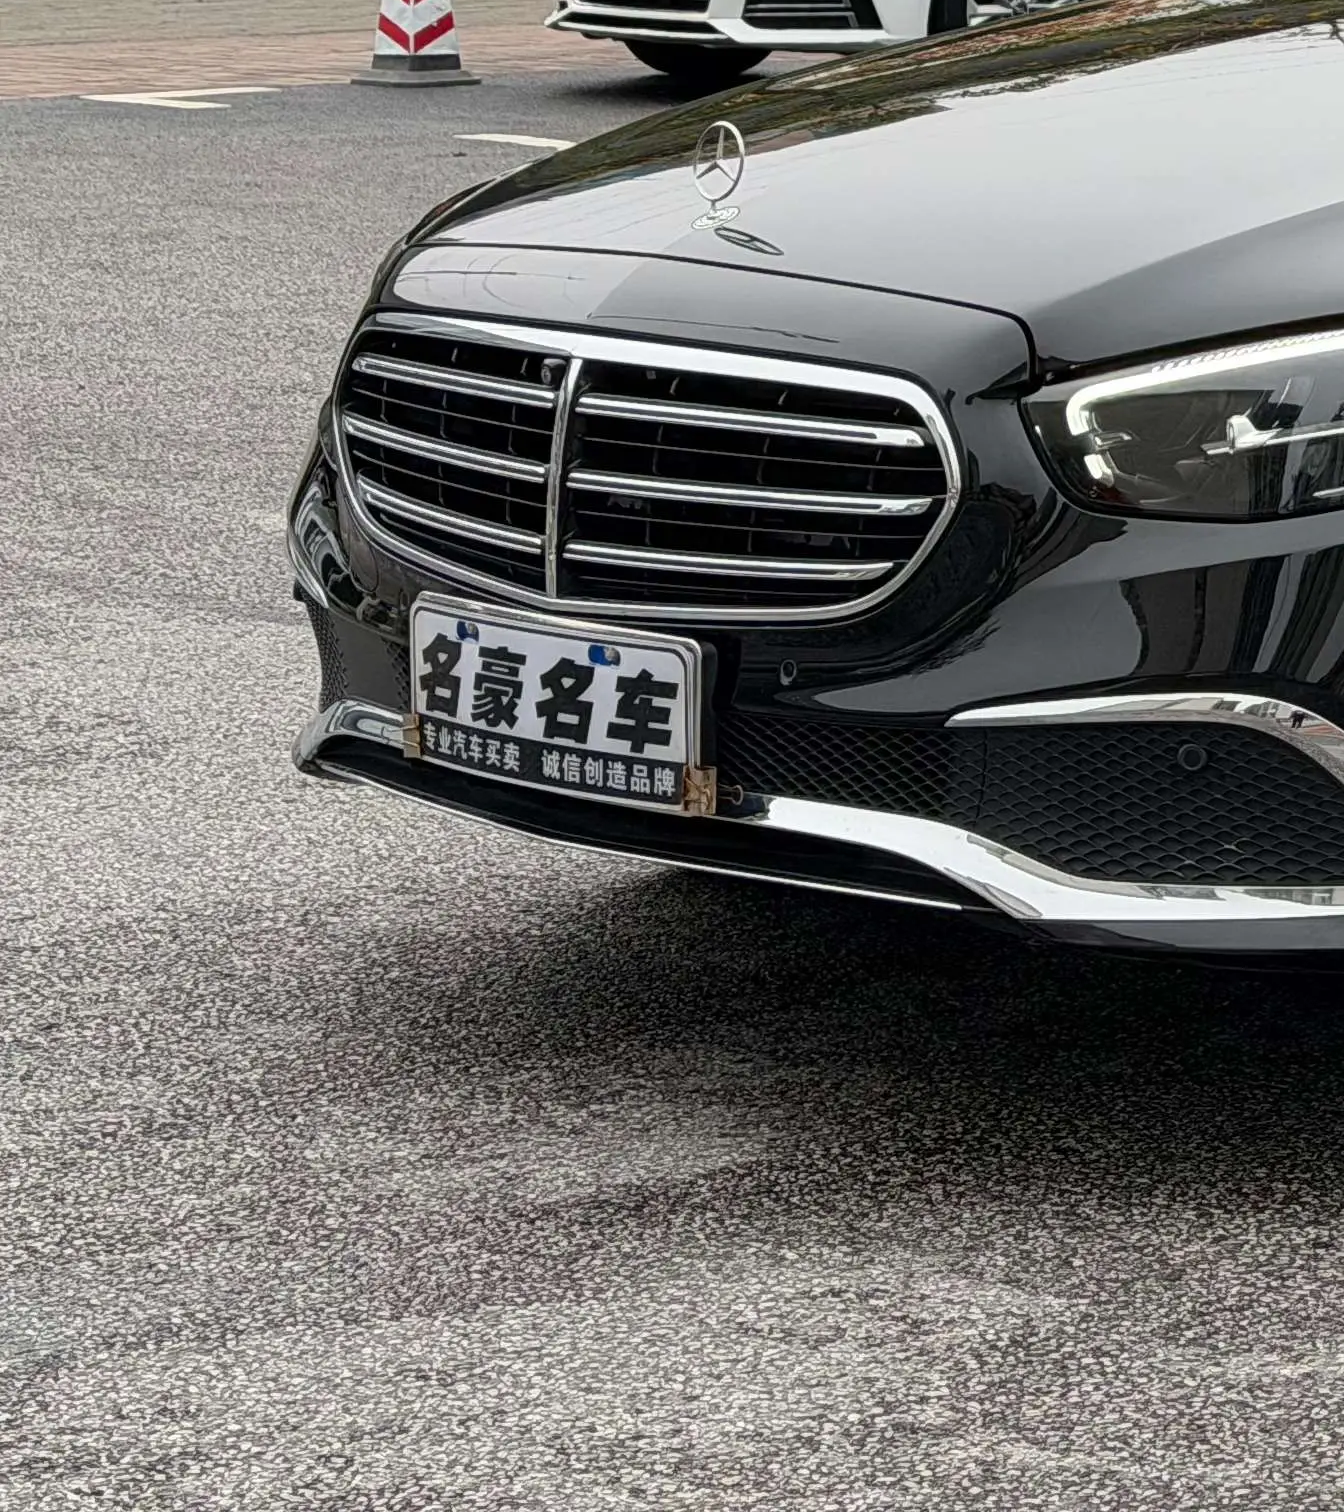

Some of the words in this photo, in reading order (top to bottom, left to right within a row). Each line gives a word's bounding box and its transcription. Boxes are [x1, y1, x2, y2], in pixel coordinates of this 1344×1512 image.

[419, 632, 679, 754] 名豪名车
[422, 722, 521, 773] 专业汽车买卖
[541, 749, 676, 798] 诚信创造品牌
